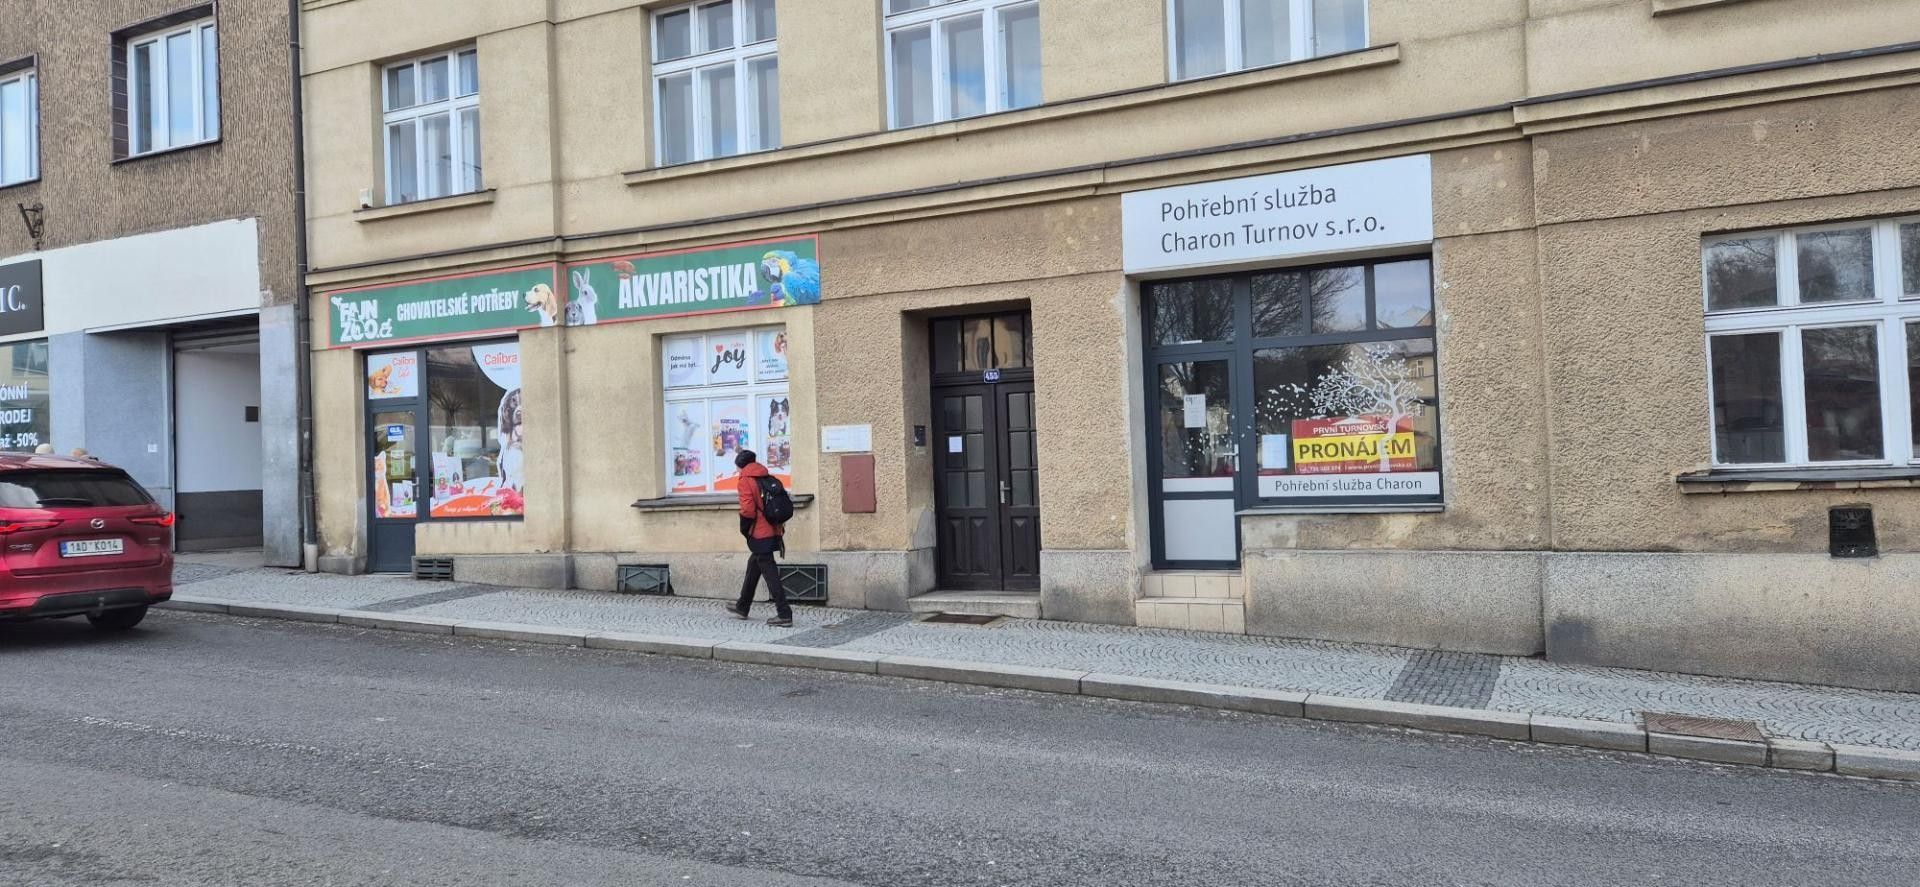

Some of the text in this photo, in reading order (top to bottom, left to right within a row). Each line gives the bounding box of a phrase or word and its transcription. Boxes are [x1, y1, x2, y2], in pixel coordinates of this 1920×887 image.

[1161, 184, 1336, 222] Pohřební služba
[1161, 215, 1386, 253] Charon Turnov s.r.o.
[618, 262, 759, 309] AKVARISTIKA
[396, 287, 519, 322] CHOVATELSKÉ POTŘEBY
[484, 352, 518, 366] Calibra
[711, 347, 745, 374] joy
[12, 432, 38, 447] -50%
[1275, 477, 1422, 492] Pohřební služba Charon
